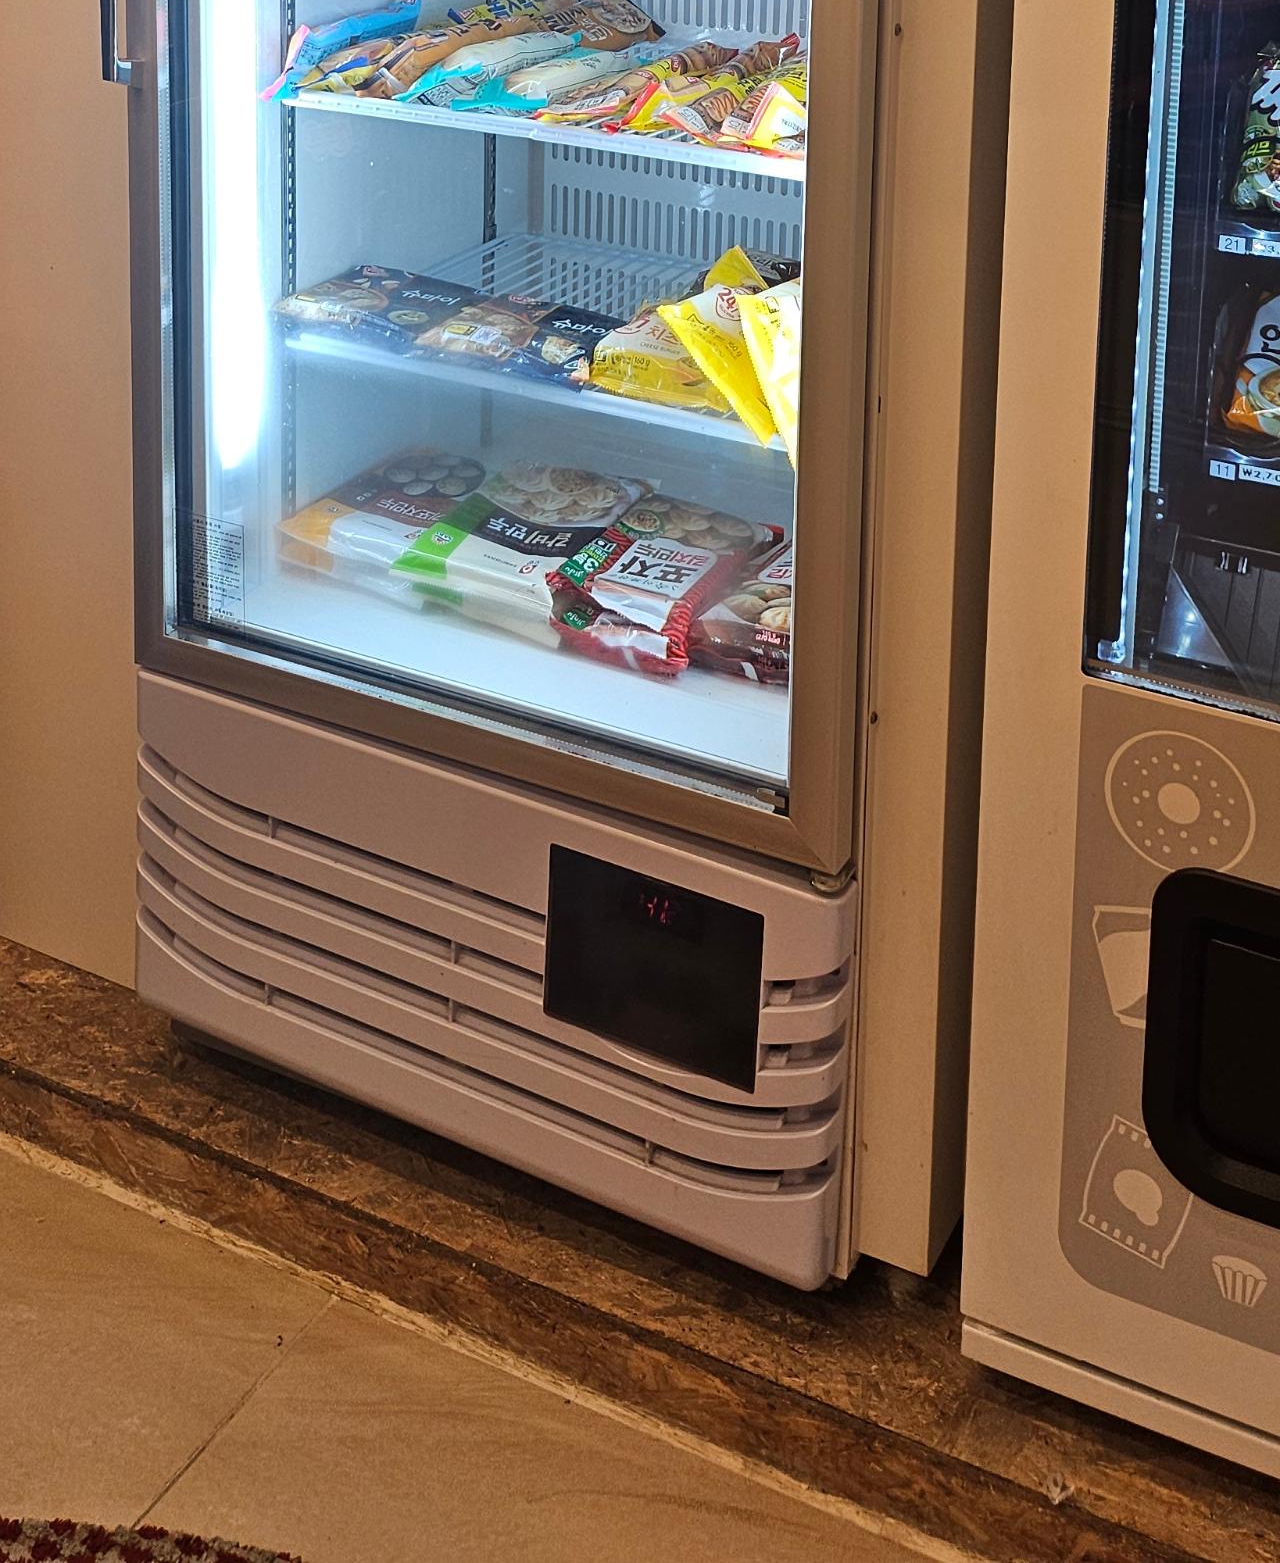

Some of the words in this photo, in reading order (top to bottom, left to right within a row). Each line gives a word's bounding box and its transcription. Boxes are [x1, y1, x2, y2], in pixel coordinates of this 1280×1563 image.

[1224, 237, 1240, 252] 21
[400, 289, 461, 308] 슈마이
[551, 318, 612, 336] 슈마이
[639, 341, 660, 352] CHEESE
[1216, 463, 1230, 478] 11
[486, 517, 573, 548] 갈비만두
[633, 543, 709, 566] 김치만두
[618, 555, 699, 584] 포자
